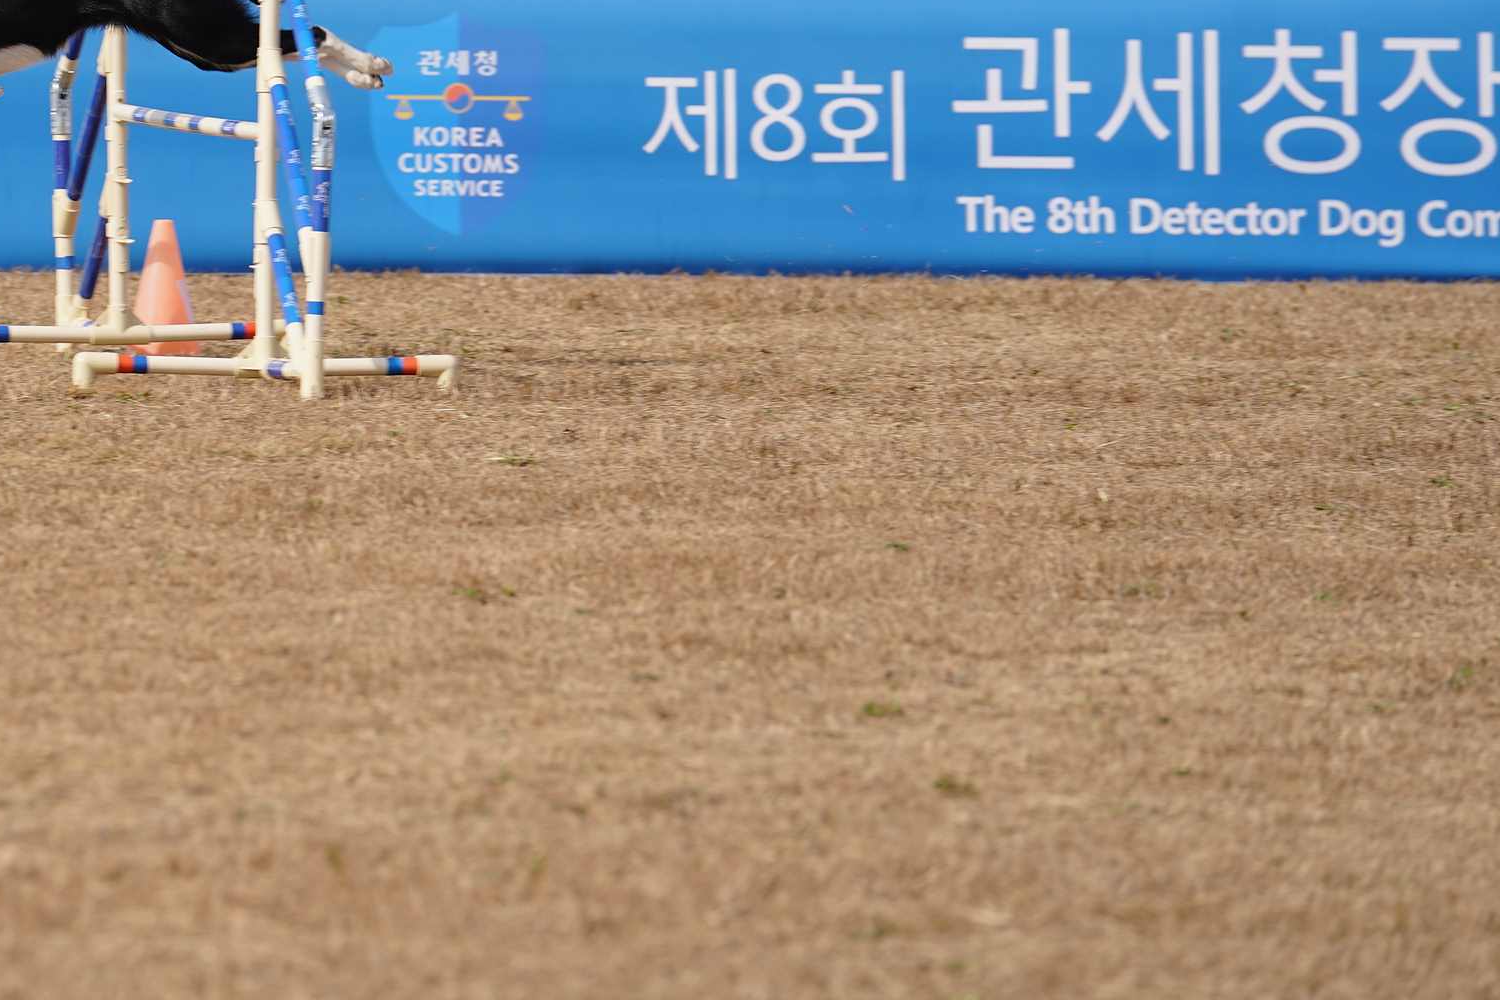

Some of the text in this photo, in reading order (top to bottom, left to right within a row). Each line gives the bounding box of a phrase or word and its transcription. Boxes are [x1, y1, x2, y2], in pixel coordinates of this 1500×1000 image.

[417, 50, 498, 77] 관세청
[642, 68, 906, 181] 제8회
[413, 127, 504, 147] KOREA
[398, 153, 520, 174] CUSTOMS
[414, 180, 504, 197] SERVICE
[956, 195, 1035, 233] The
[1047, 196, 1116, 234] 8th
[1129, 198, 1307, 236] Detector
[1319, 200, 1405, 248] Dog
